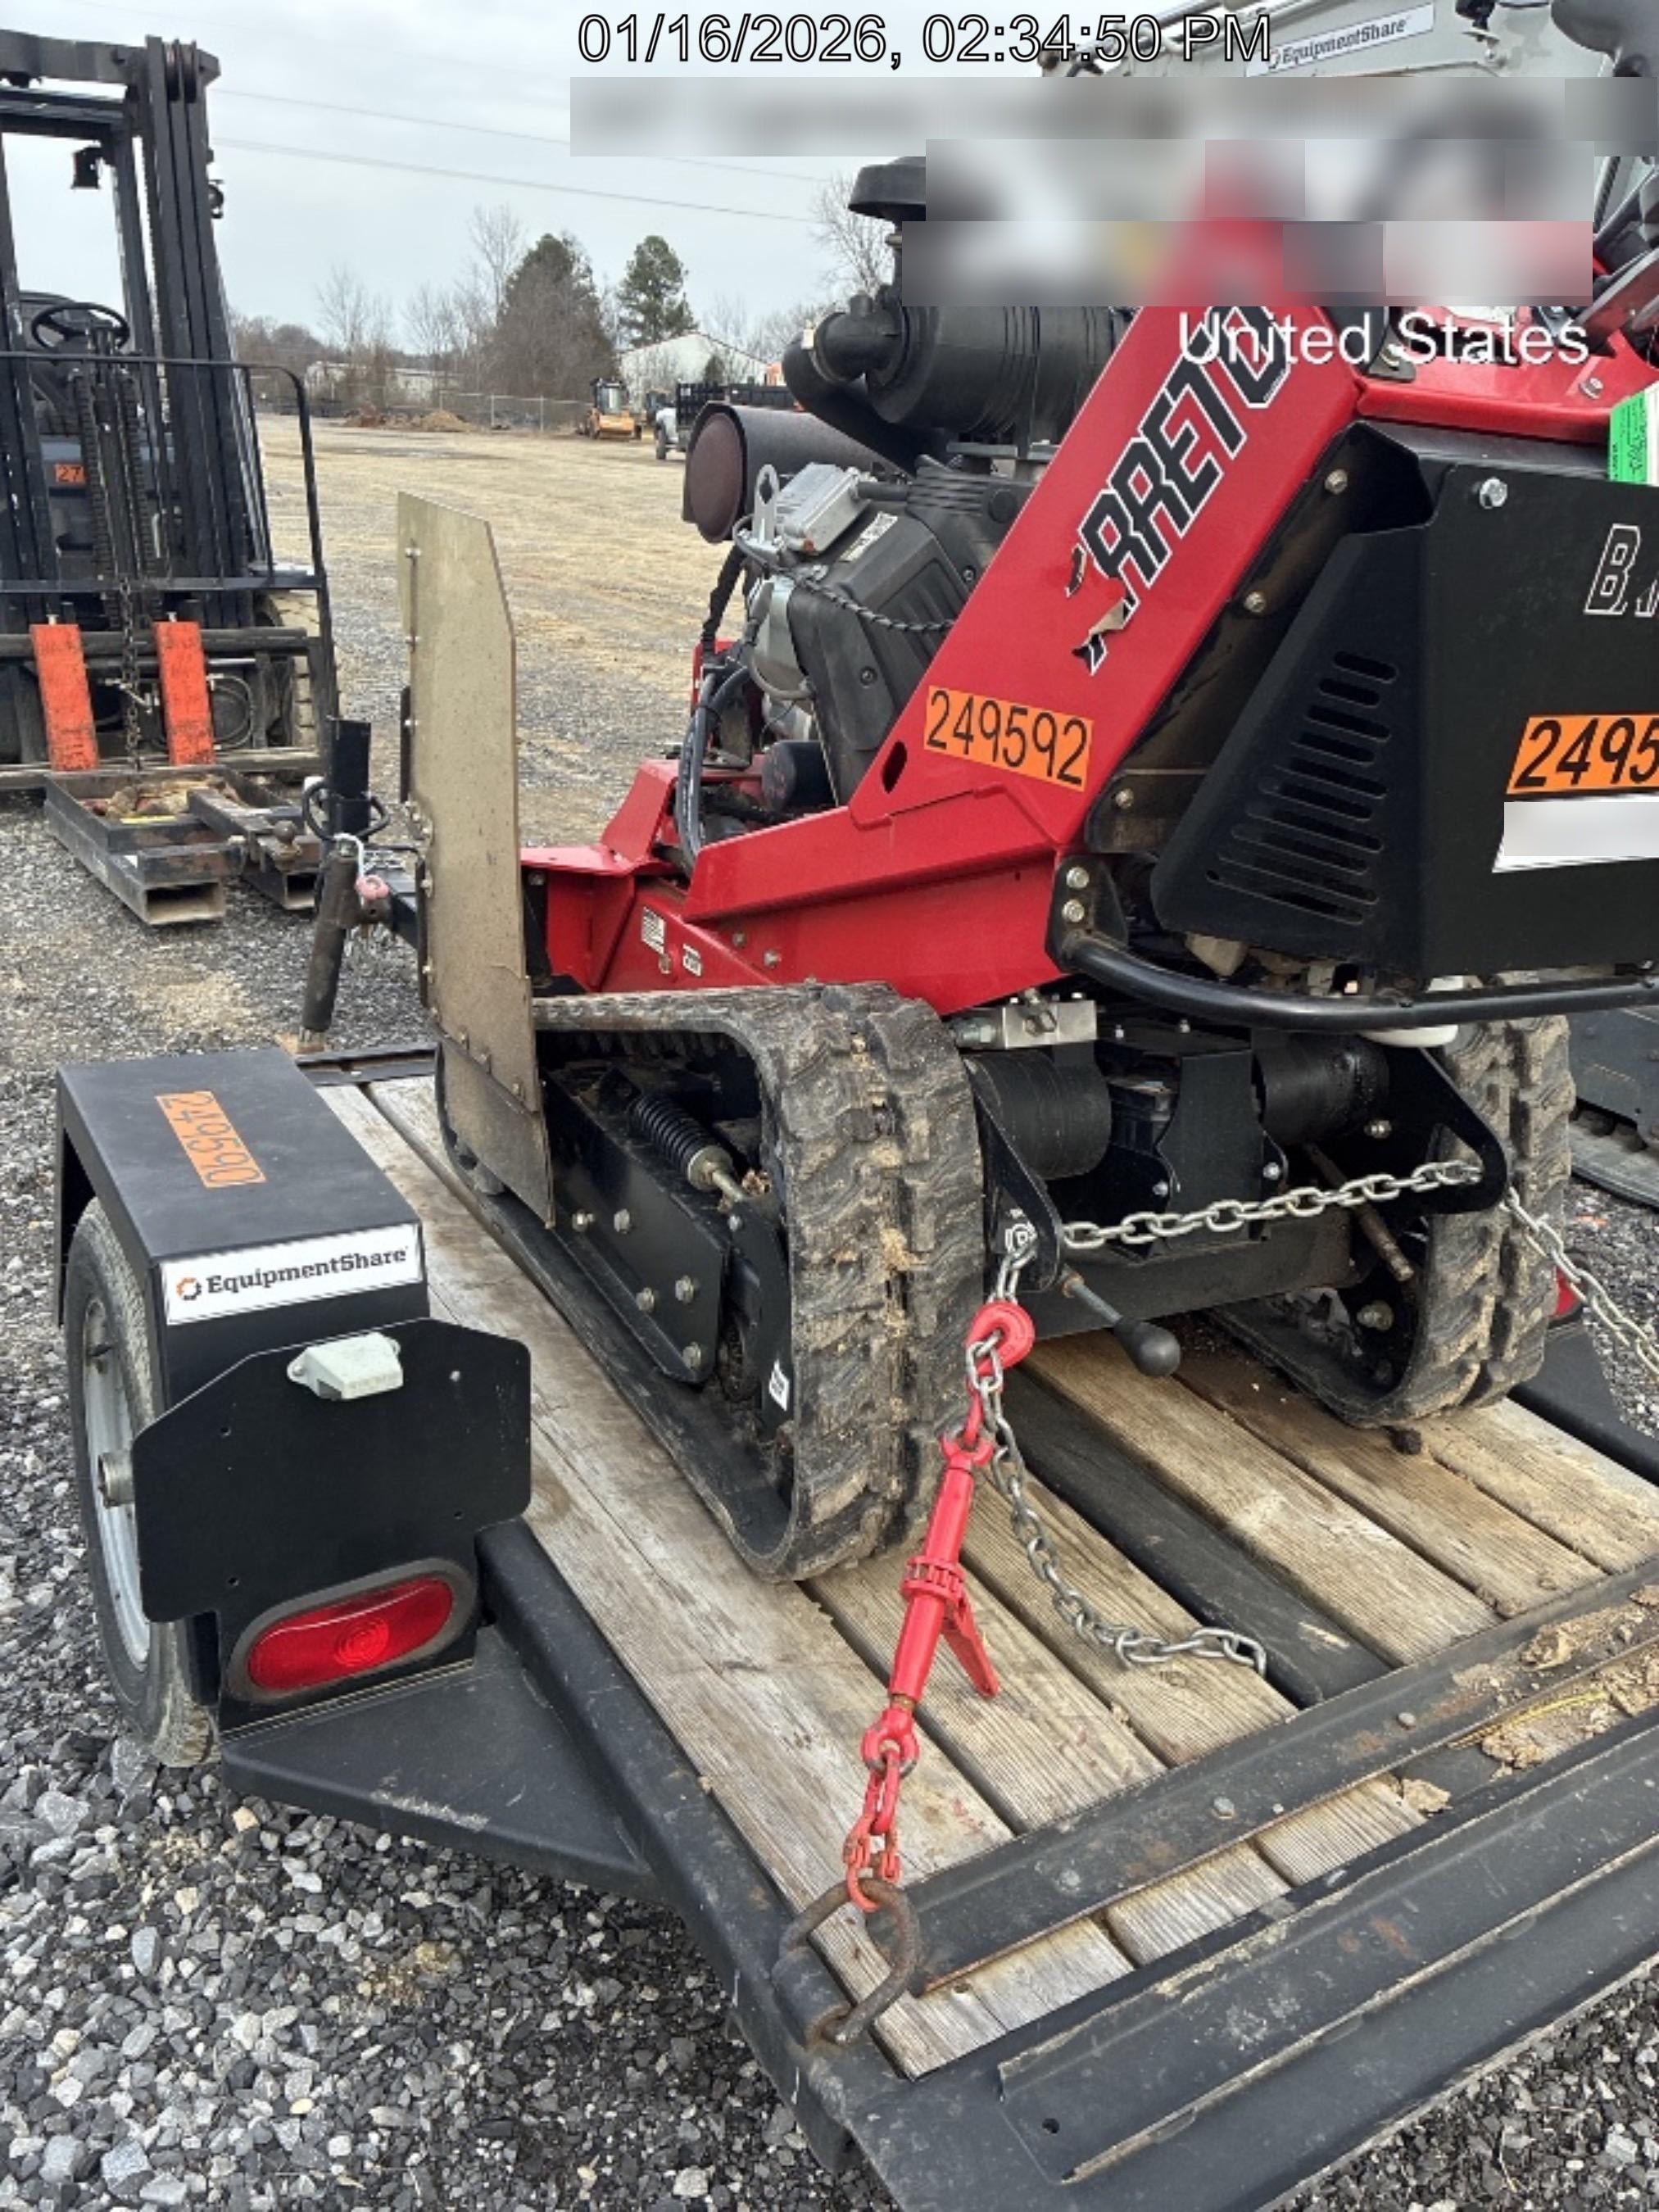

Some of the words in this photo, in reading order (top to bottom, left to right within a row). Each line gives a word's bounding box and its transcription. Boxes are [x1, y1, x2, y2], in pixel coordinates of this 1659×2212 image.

[1282, 18, 1407, 66] EquipmentShare
[1067, 306, 1292, 676] RRETO
[927, 689, 1088, 786] 249592
[206, 1246, 408, 1294] EquipmentShare
